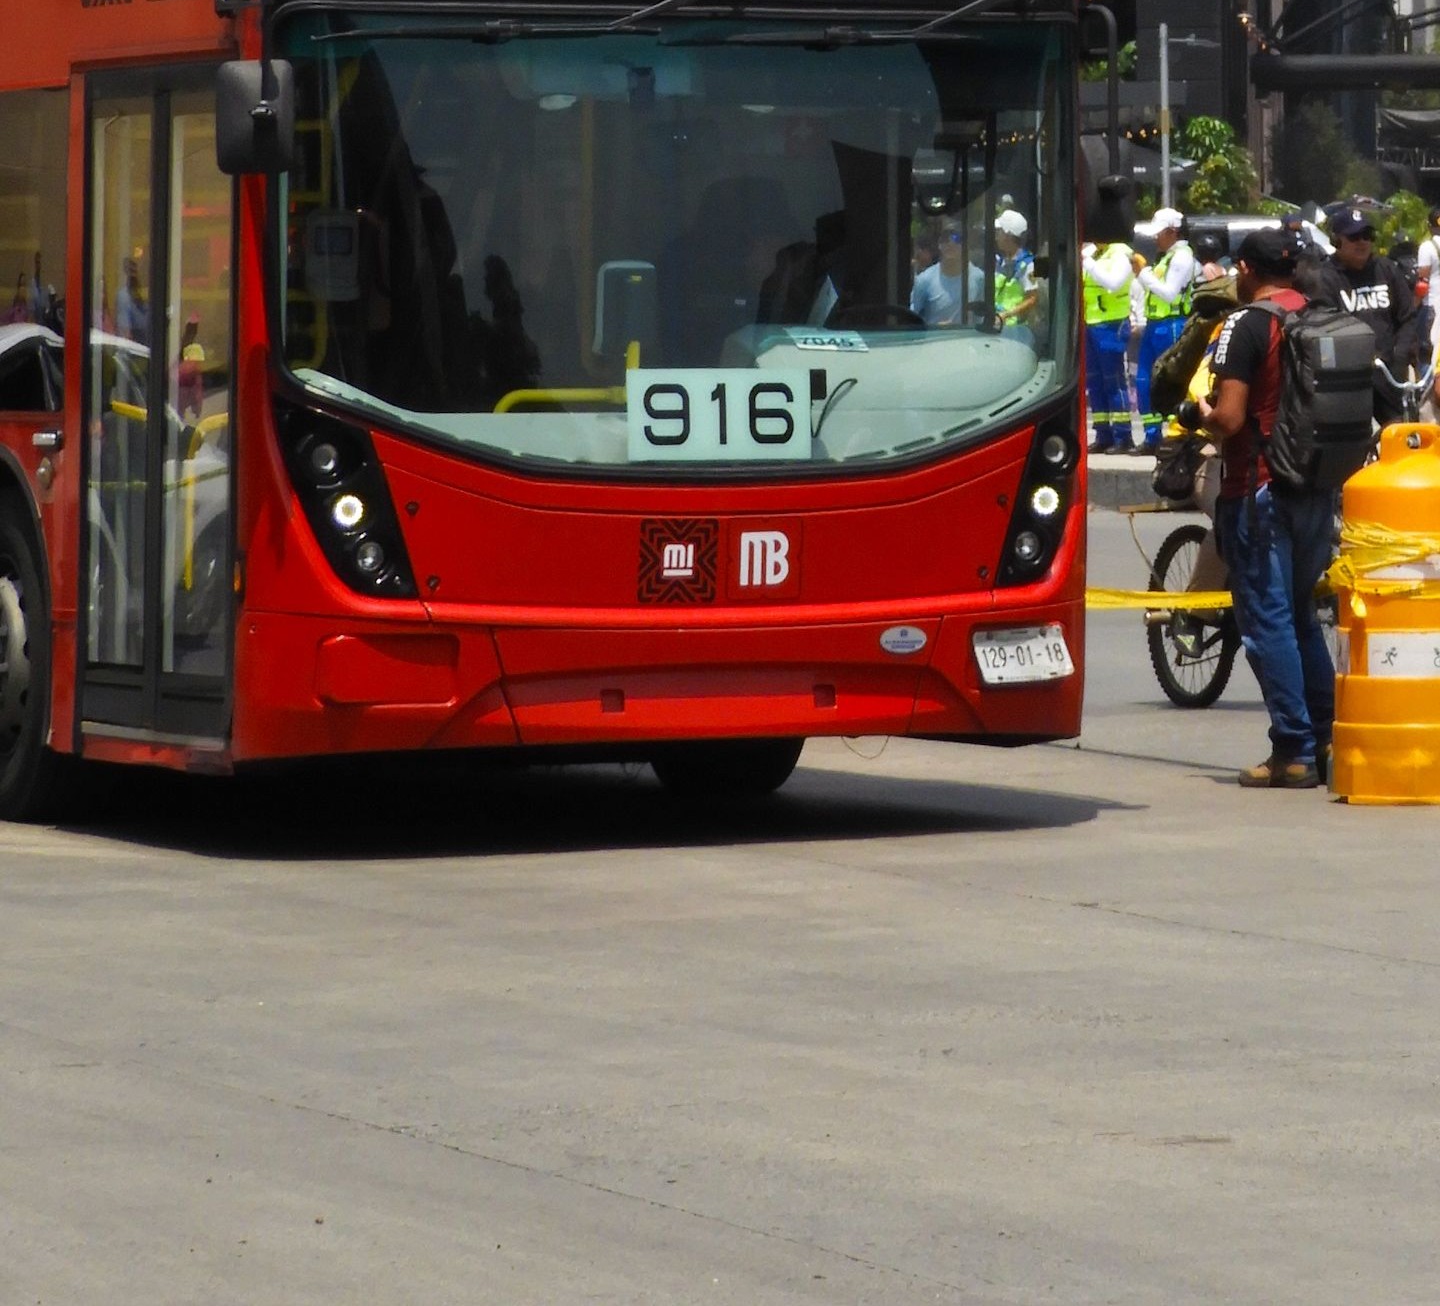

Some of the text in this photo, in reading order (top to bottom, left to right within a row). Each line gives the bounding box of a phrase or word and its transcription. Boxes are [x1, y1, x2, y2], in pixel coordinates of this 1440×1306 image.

[1339, 284, 1391, 313] VANS
[643, 382, 795, 446] 916
[982, 642, 1064, 669] 129-01-18
